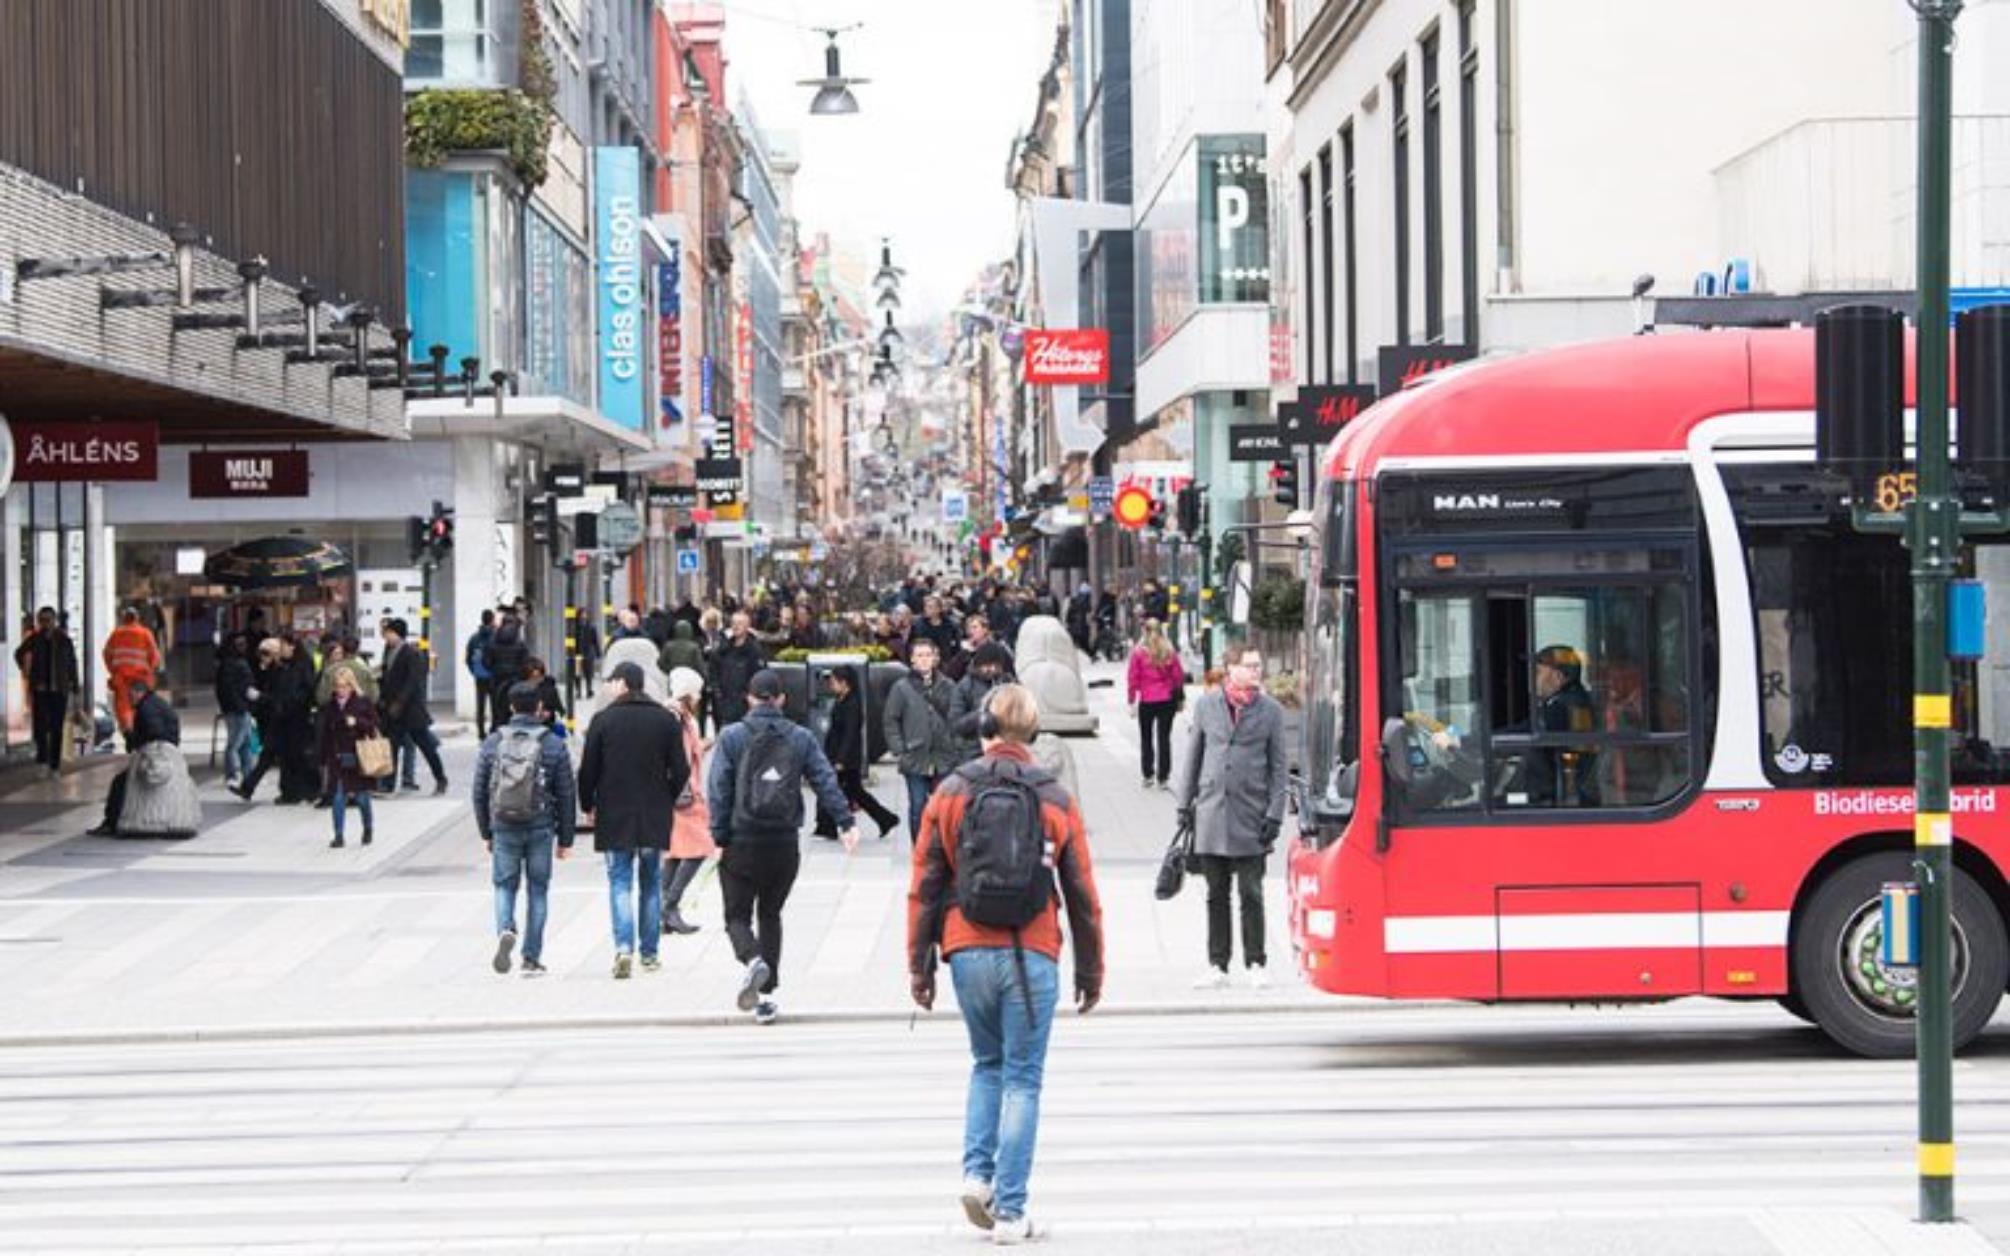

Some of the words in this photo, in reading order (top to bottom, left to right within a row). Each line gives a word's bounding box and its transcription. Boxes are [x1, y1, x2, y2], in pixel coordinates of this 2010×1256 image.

[1217, 185, 1249, 249] P
[605, 195, 637, 305] ohlson
[606, 310, 637, 379] clas
[27, 435, 140, 463] ÅHLÉNS
[225, 459, 273, 480] MUJI
[1433, 494, 1499, 510] MAN
[1877, 473, 1917, 512] 65
